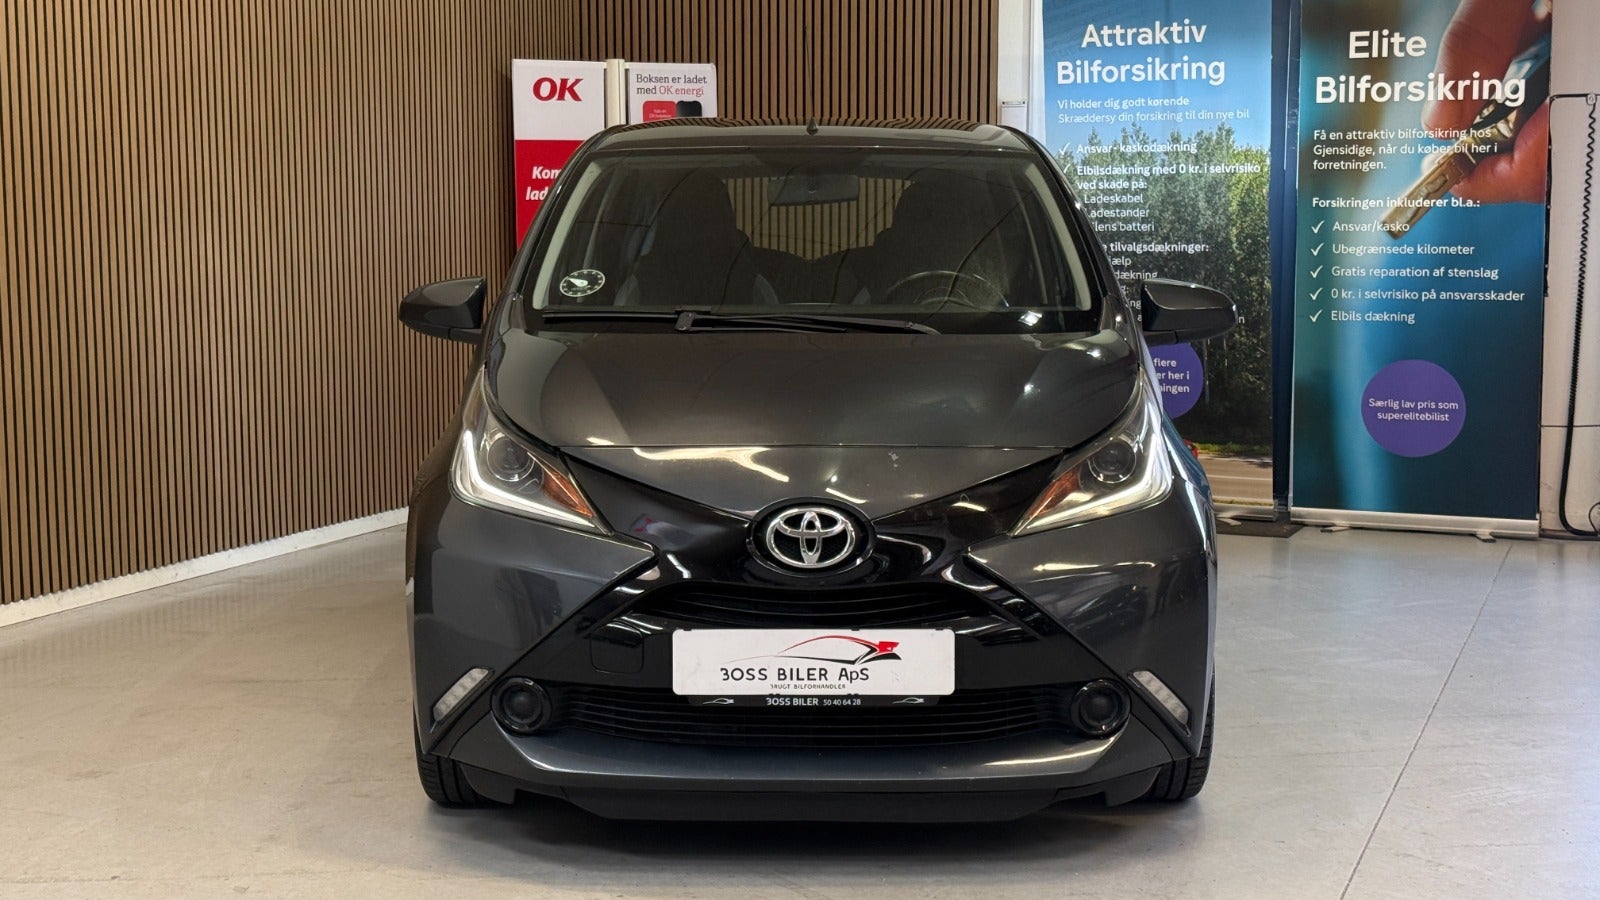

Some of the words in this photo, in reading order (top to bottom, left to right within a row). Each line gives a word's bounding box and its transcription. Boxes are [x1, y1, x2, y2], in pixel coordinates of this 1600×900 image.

[1081, 18, 1207, 48] Attraktiv
[1349, 29, 1427, 59] Elite
[1057, 55, 1225, 85] Bilforsikring
[636, 73, 669, 84] Boksen
[671, 76, 681, 84] er
[683, 74, 707, 84] ladet
[533, 77, 583, 102] OK
[636, 86, 657, 95] med
[659, 85, 673, 95] OK
[675, 86, 704, 97] energi
[1315, 71, 1526, 107] Bilforsikring
[1057, 100, 1068, 109] Vi
[1070, 99, 1102, 109] holder
[1104, 98, 1120, 110] dig
[1122, 98, 1145, 110] godt
[1148, 96, 1189, 107] kørende
[1058, 112, 1116, 124] Skræddersy
[1118, 112, 1134, 122] din
[1136, 110, 1183, 122] forsikring
[1185, 110, 1195, 120] til
[1198, 109, 1213, 120] din
[1216, 110, 1234, 121] nye
[1237, 108, 1250, 119] bil
[1314, 128, 1327, 140] Få
[1329, 131, 1343, 140] en
[1346, 128, 1395, 140] attraktiv
[1398, 127, 1467, 142] bilforsikring
[1469, 127, 1491, 138] hos
[1120, 142, 1197, 154] kaskodækning
[1313, 143, 1376, 157] Gjensidige,
[1378, 142, 1398, 154] når
[1400, 143, 1415, 154] du
[1417, 143, 1450, 154] køber
[1454, 142, 1469, 154] bil
[1471, 142, 1491, 153] her
[1077, 164, 1150, 177] Elbilsdækning
[1153, 164, 1176, 175] med
[1179, 164, 1186, 174] 0
[1189, 163, 1202, 174] kr.
[1210, 163, 1261, 174] selvrisiko
[1313, 159, 1387, 172] forretningen.
[1077, 179, 1097, 190] ved
[1099, 179, 1129, 190] skade
[1131, 179, 1148, 191] på:
[1084, 193, 1143, 204] Ladeskabel
[1312, 197, 1384, 210] Forsikringen
[1386, 196, 1449, 208] inkluderer
[1451, 197, 1481, 208] bl.a.:
[1119, 221, 1155, 231] batteri
[1333, 220, 1410, 232] Ansvar/kasko
[1110, 241, 1209, 254] tilvalgsdækninger:
[1332, 243, 1415, 257] Ubegrænsede
[1417, 243, 1475, 255] kilometer
[1331, 266, 1366, 277] Gratis
[1369, 266, 1431, 279] reparation
[1433, 266, 1445, 277] af
[1448, 267, 1499, 280] stenslag
[1331, 288, 1339, 299] 0
[1341, 288, 1355, 299] kr.
[1364, 288, 1419, 300] selvrisiko
[1421, 288, 1436, 302] på
[1439, 290, 1525, 302] ansvarsskader
[1331, 310, 1362, 321] Elbils
[1365, 310, 1416, 324] dækning
[1168, 371, 1184, 380] her
[1368, 398, 1400, 410] Særlig
[1401, 399, 1416, 409] lav
[1418, 399, 1436, 411] pris
[1438, 401, 1459, 410] som
[1377, 411, 1450, 422] superelitebilist
[777, 667, 828, 681] BILER
[838, 667, 869, 684] ApS
[792, 697, 819, 706] BILER
